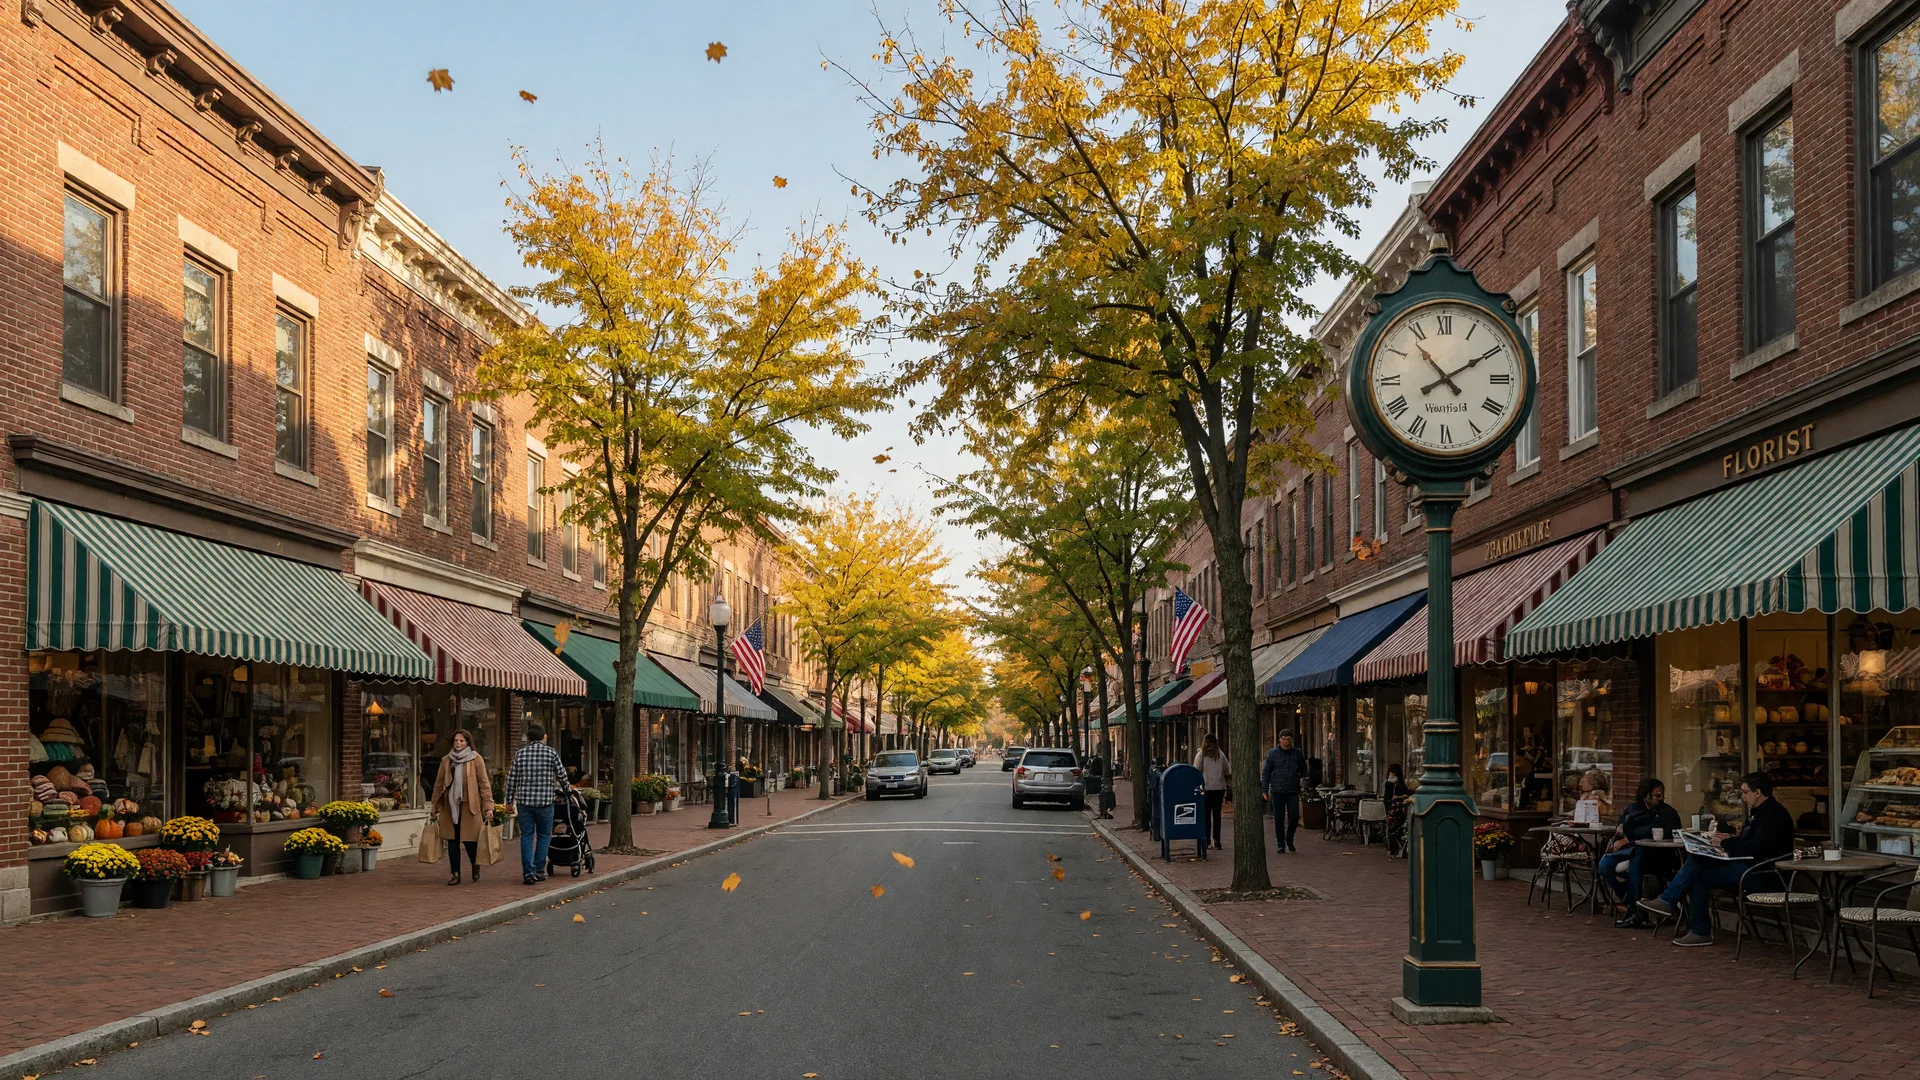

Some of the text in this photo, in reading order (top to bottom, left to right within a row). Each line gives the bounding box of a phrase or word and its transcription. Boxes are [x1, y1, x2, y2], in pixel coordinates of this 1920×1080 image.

[1408, 321, 1427, 341] XI
[1437, 315, 1452, 335] XII
[1465, 323, 1477, 341] I
[1490, 374, 1510, 384] III
[1440, 424, 1453, 444] VI
[1468, 419, 1482, 437] V
[1723, 423, 1814, 479] FLORIST
